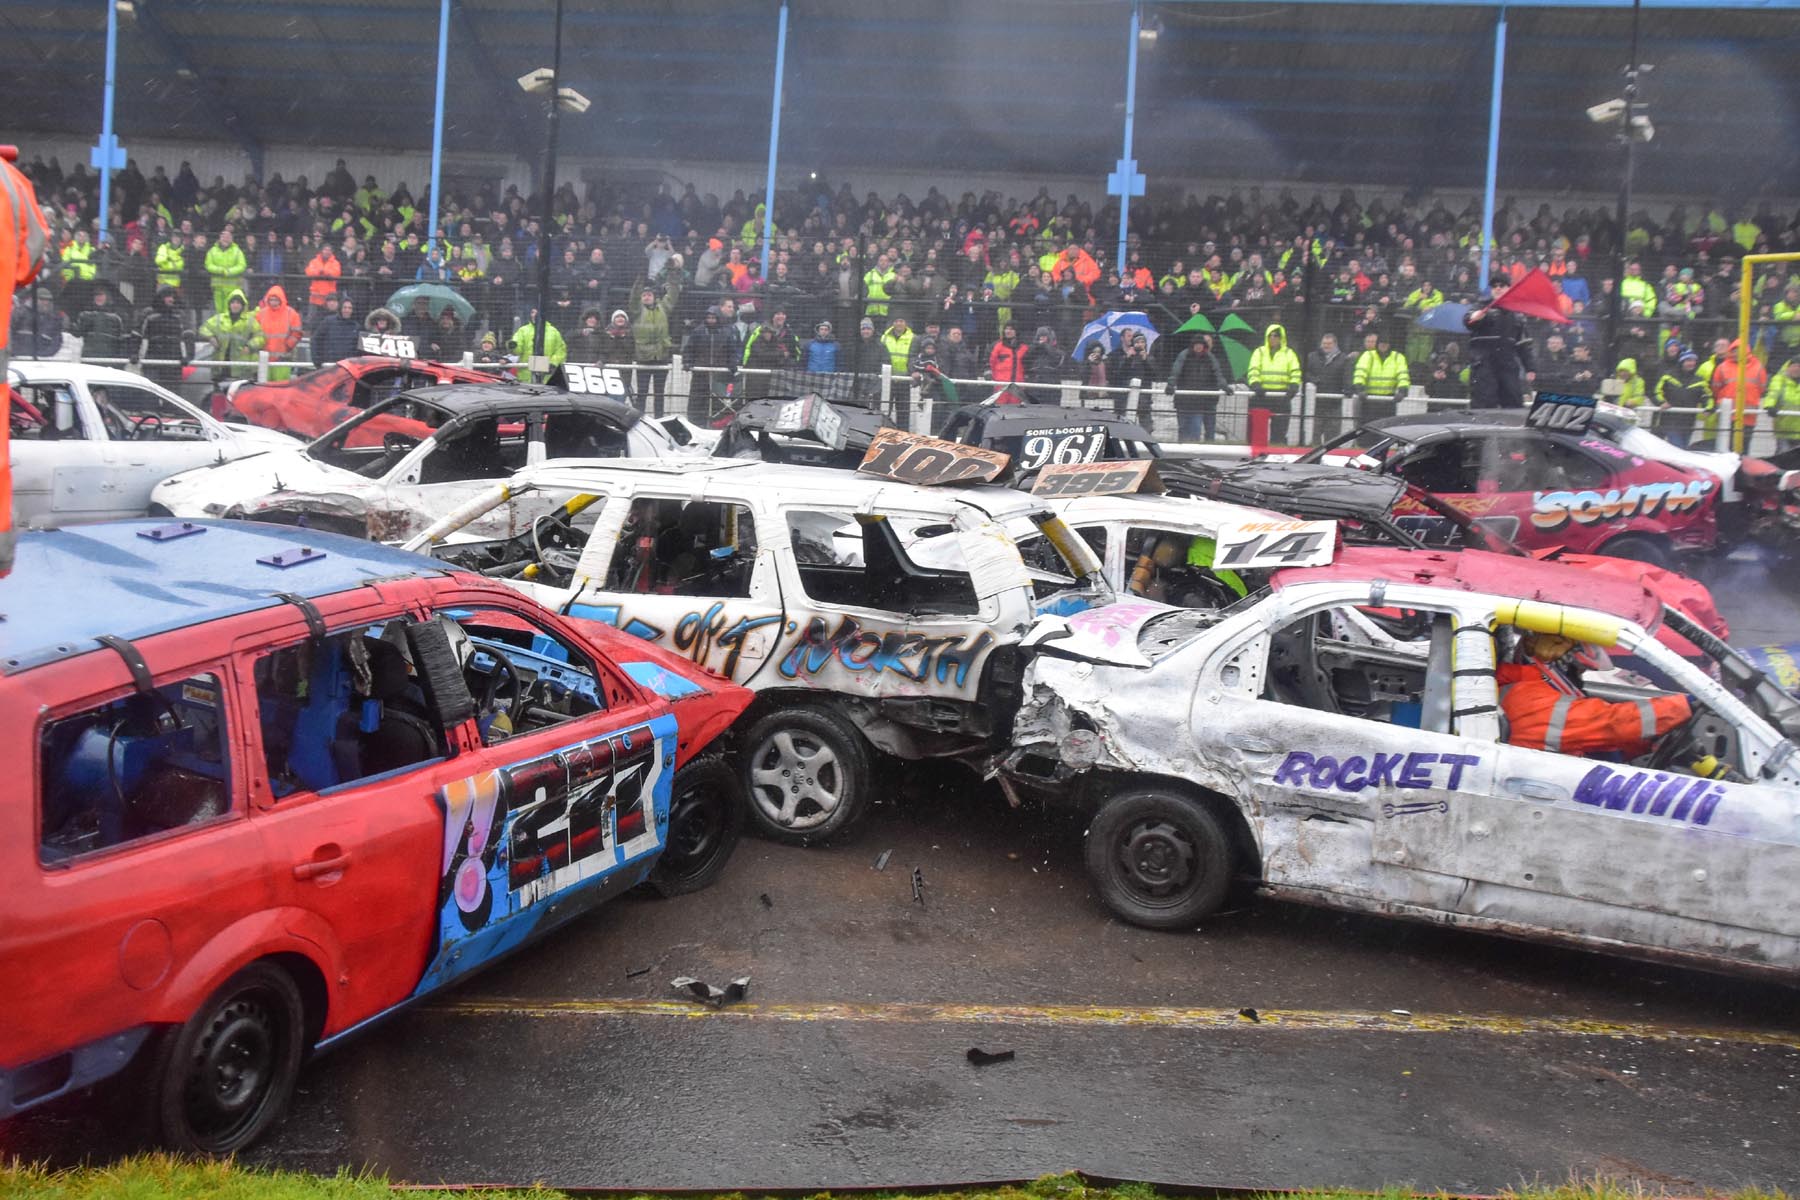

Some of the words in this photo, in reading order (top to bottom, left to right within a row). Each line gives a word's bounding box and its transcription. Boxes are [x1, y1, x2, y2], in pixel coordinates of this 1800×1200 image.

[362, 337, 416, 359] 548
[563, 364, 625, 396] 366
[1026, 429, 1055, 437] SONIC
[1529, 402, 1594, 431] 402
[858, 441, 1000, 485] 100
[1021, 433, 1105, 469] 961
[1033, 471, 1139, 495] 399
[1220, 531, 1328, 565] 14
[1273, 751, 1480, 792] ROCKET
[1572, 764, 1728, 826] Willi
